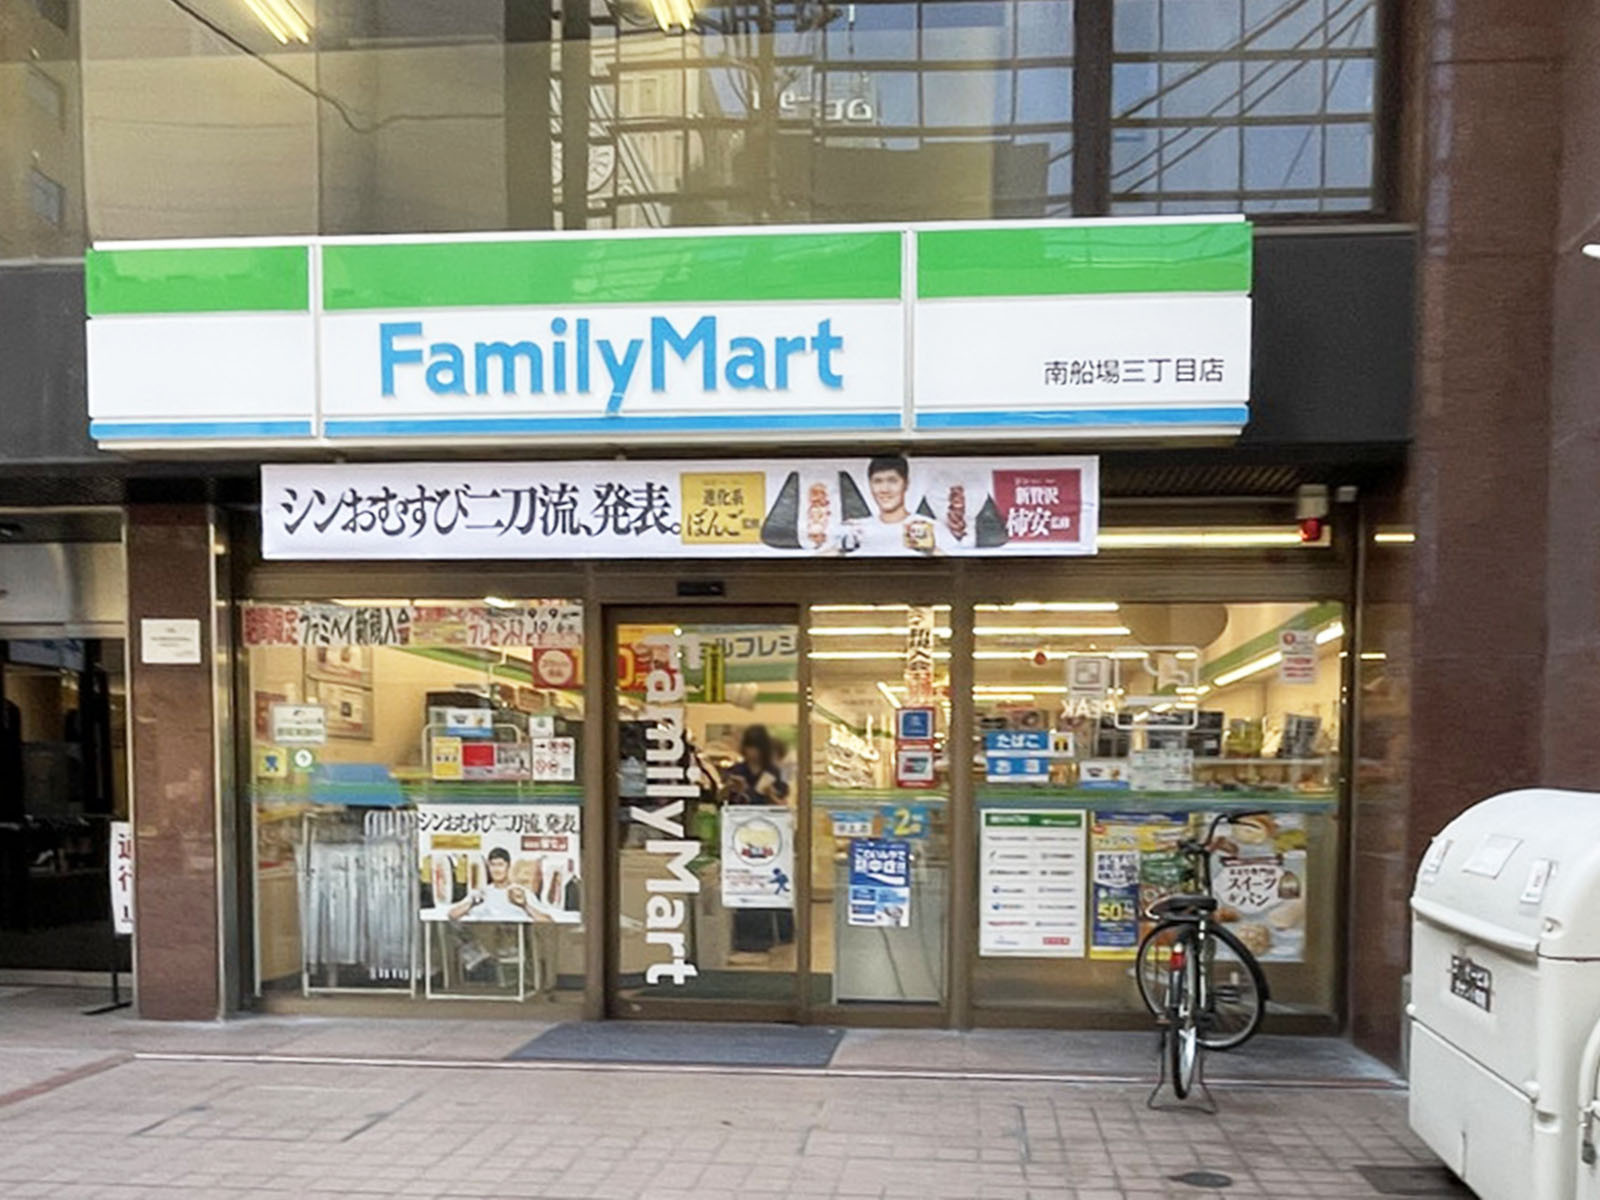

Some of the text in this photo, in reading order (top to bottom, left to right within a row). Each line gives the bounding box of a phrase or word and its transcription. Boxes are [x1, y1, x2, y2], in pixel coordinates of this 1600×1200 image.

[379, 315, 844, 416] FamilyMart
[1043, 357, 1225, 386] 南船場三丁目店
[280, 482, 682, 538] シンおむすび二刀流、発表。
[997, 733, 1041, 749] たばこ
[630, 633, 701, 985] FamilyMart
